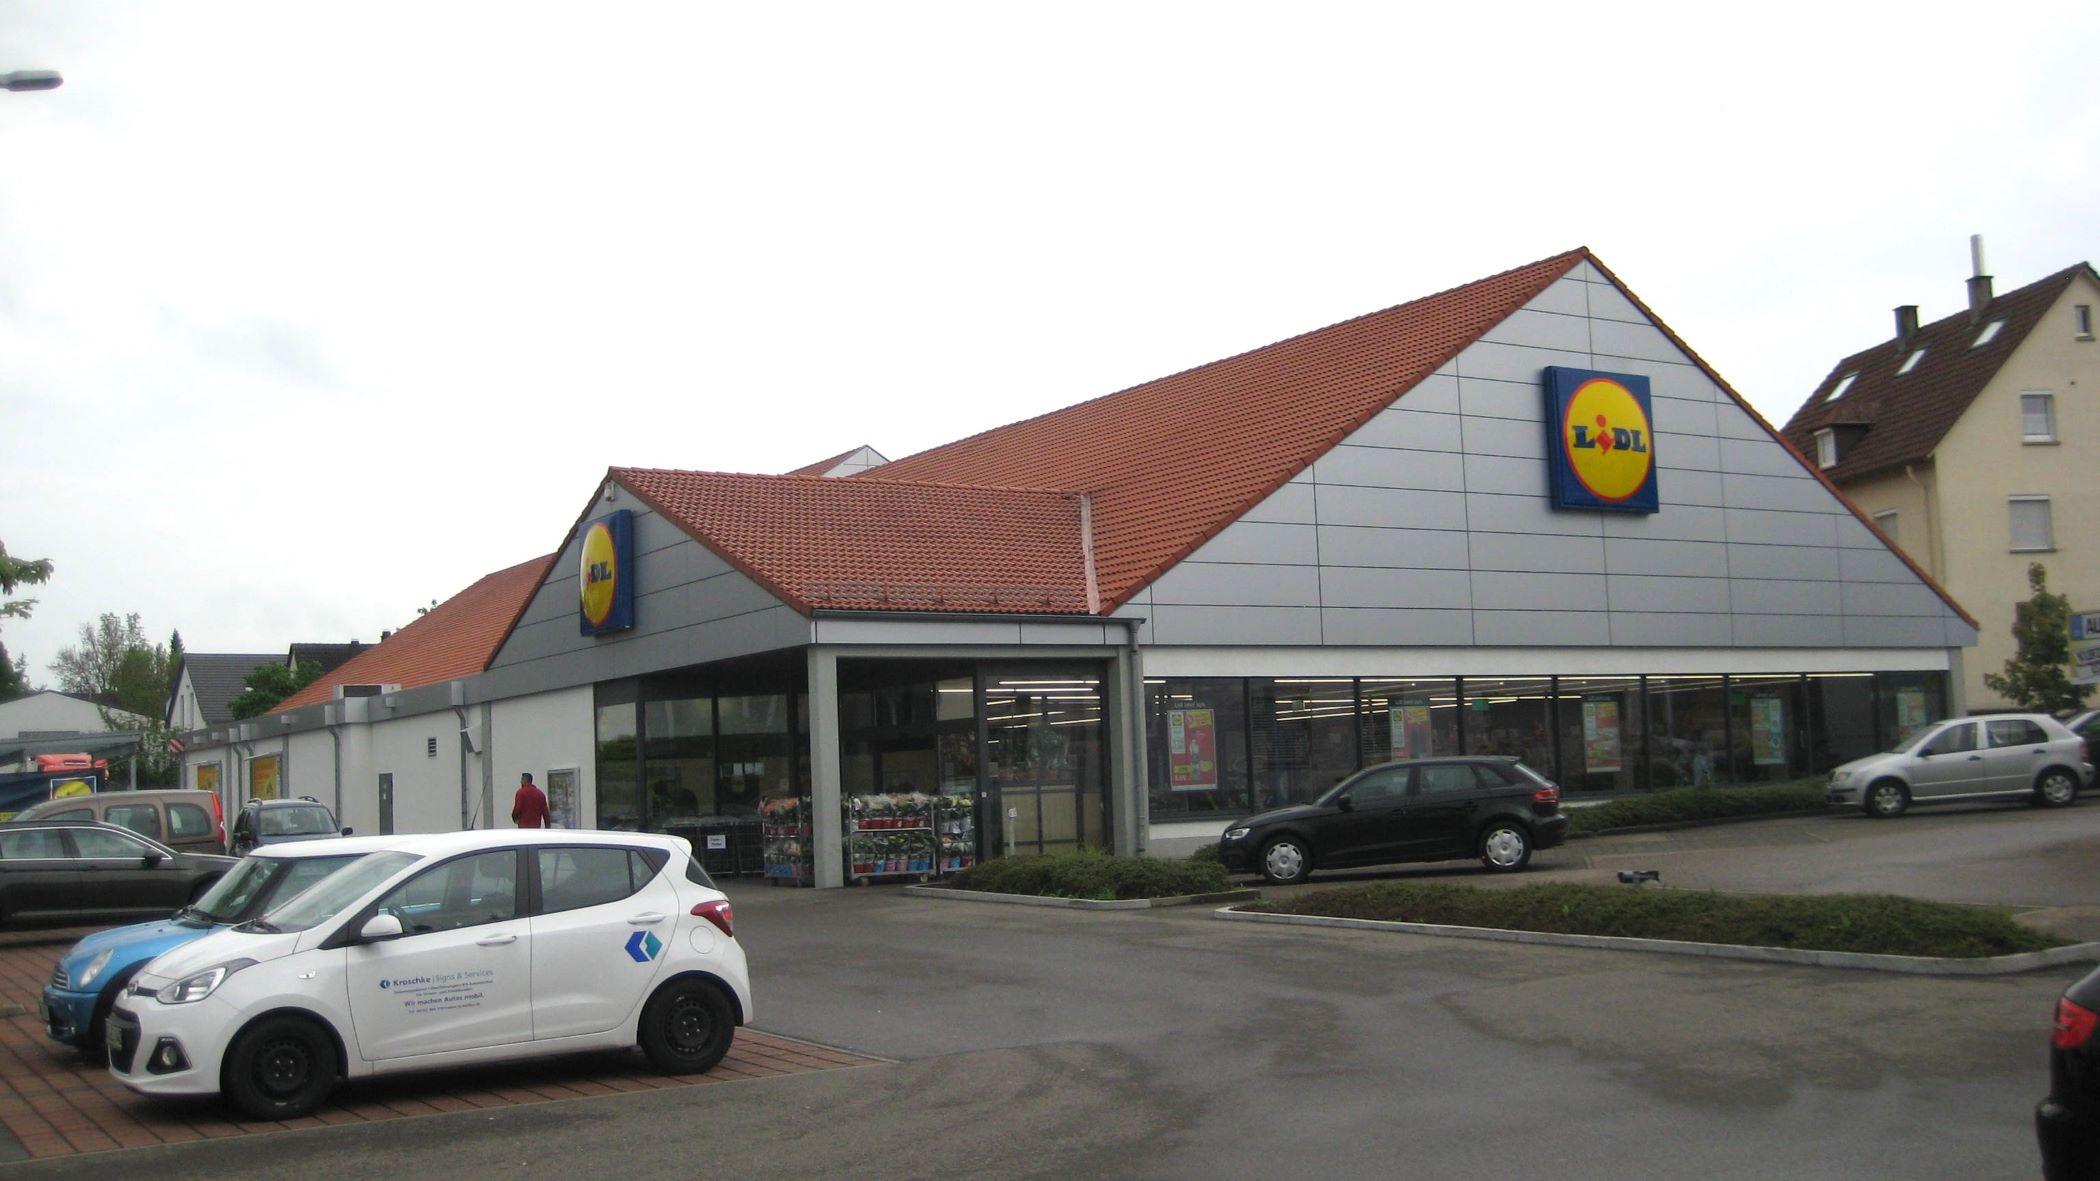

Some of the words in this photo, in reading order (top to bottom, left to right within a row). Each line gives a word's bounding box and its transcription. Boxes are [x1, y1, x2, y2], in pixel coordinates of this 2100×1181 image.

[393, 976, 432, 987] Kroschke
[435, 973, 455, 984] Signs
[456, 972, 463, 980] &
[464, 968, 494, 980] Services
[404, 1000, 416, 1008] Wir
[417, 997, 443, 1006] machen
